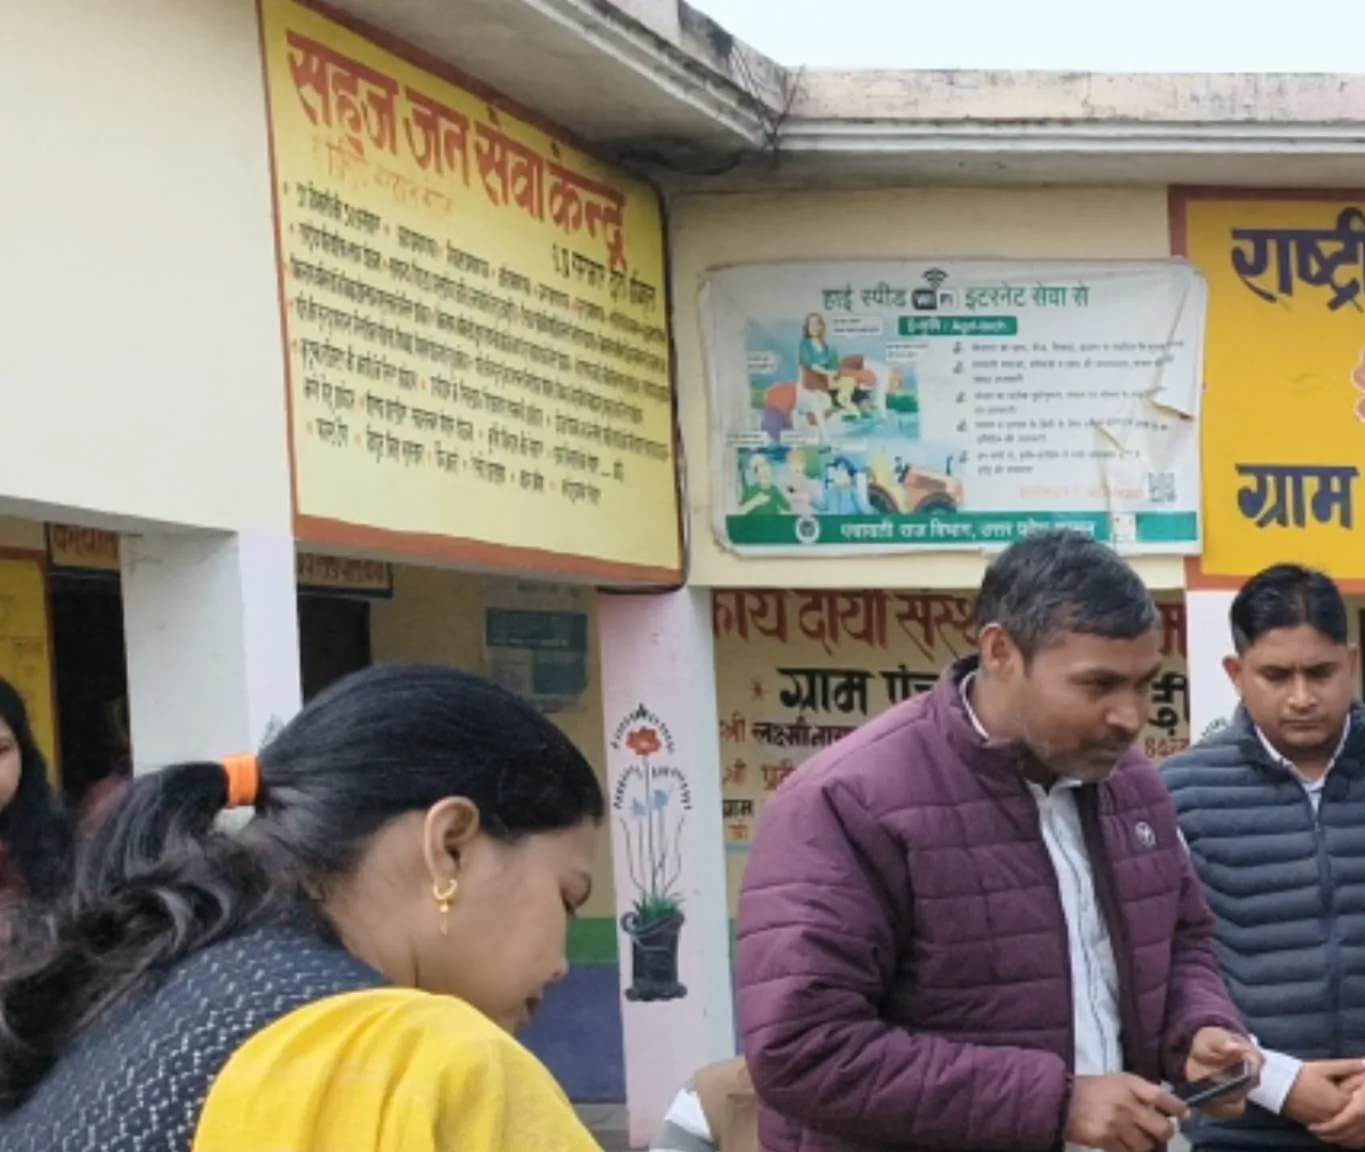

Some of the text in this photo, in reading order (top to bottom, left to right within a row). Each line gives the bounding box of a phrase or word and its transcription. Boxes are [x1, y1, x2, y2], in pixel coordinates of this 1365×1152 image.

[403, 84, 469, 189] जन
[474, 104, 544, 224] सेवा
[822, 281, 853, 311] हाई
[1032, 281, 1066, 308] सेवा
[1072, 281, 1090, 308] से
[1235, 464, 1360, 529] ग्राम
[776, 667, 875, 715] ग्राम
